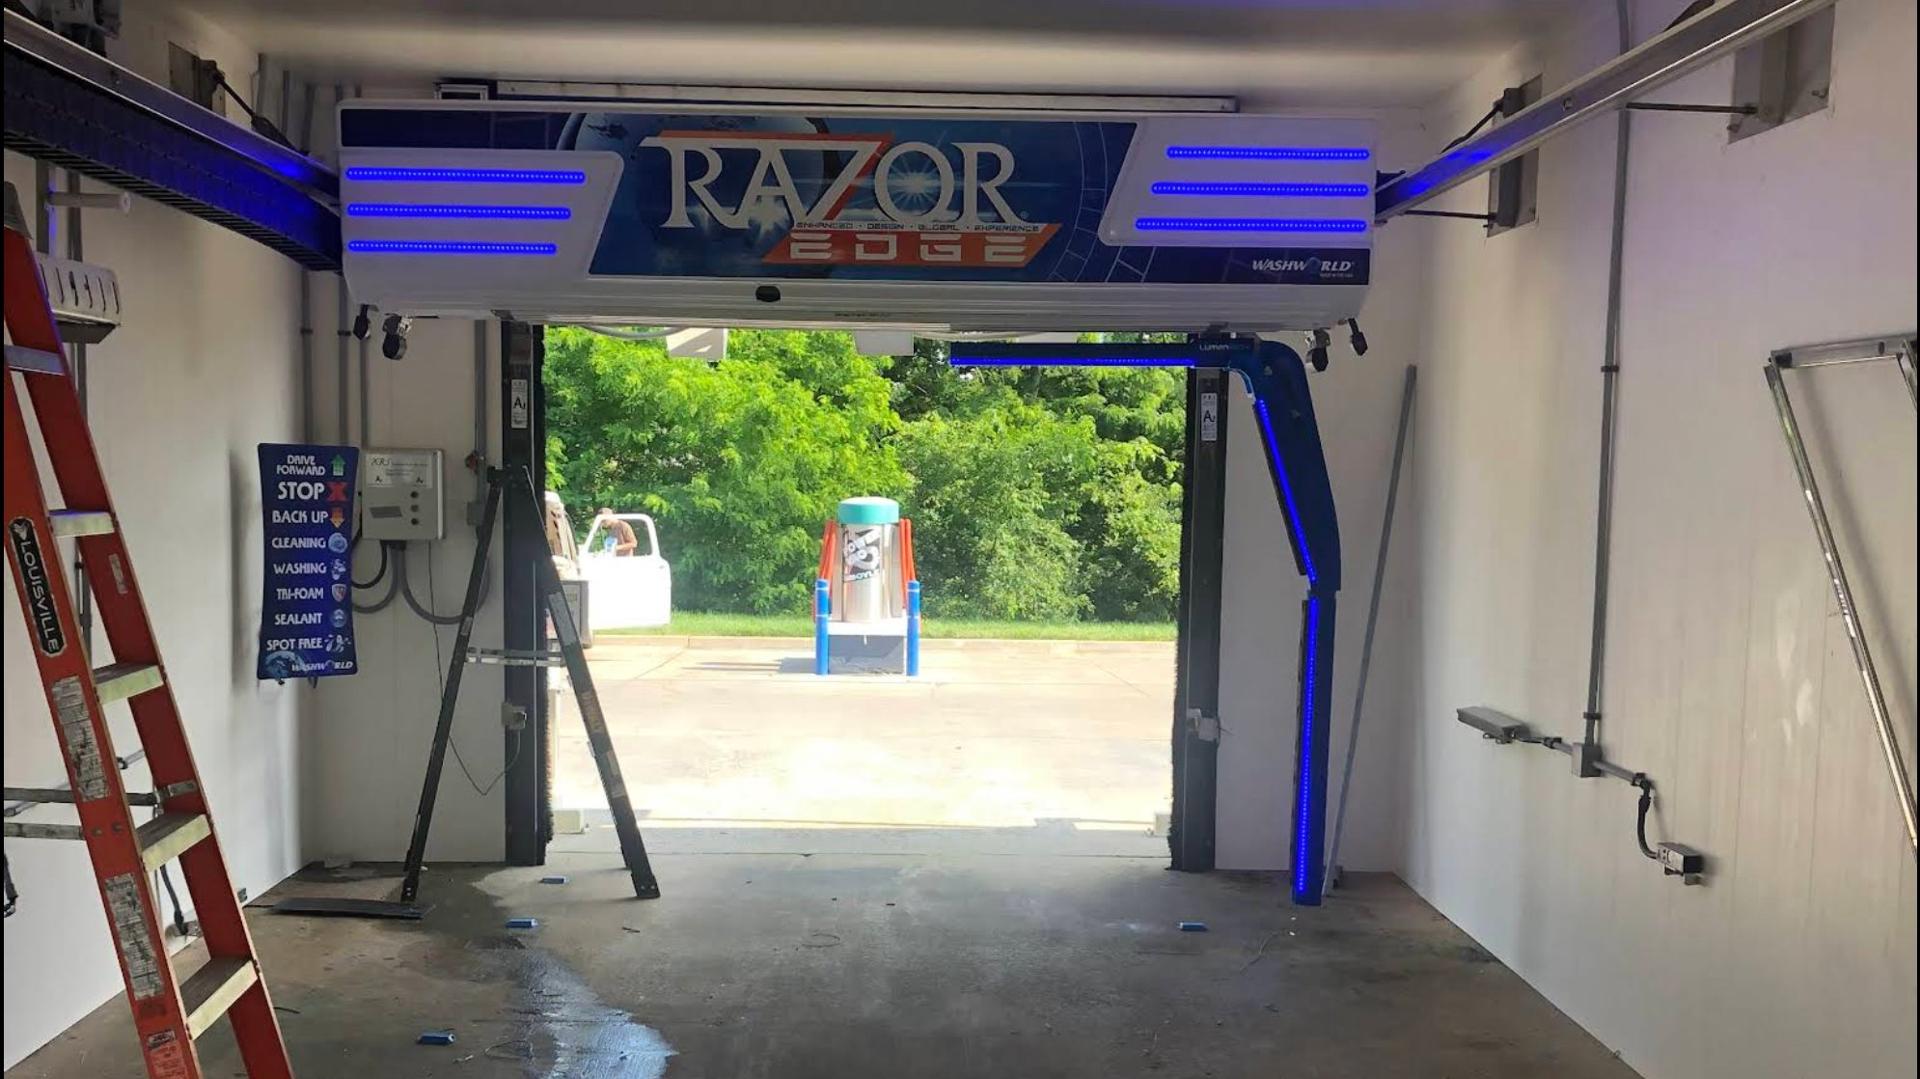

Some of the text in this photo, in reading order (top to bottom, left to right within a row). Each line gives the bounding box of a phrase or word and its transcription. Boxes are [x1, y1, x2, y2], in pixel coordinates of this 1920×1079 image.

[641, 137, 1028, 229] RAZOR
[796, 222, 853, 230] ENHANCED
[867, 223, 905, 231] DESIGN
[974, 225, 1040, 233] EXPERIENCE
[789, 233, 1026, 262] EDGE
[287, 454, 315, 466] DRIVE
[276, 464, 326, 476] FORWARD
[277, 482, 325, 500] STOP
[272, 510, 328, 524] BACK UP
[272, 537, 326, 549] CLEANING
[273, 563, 326, 574] WASHING
[20, 541, 59, 651] LOUISVILLE
[277, 587, 324, 600] TRI-FOAM
[274, 612, 322, 625] SEALANT
[267, 637, 323, 650] SPOT FREE
